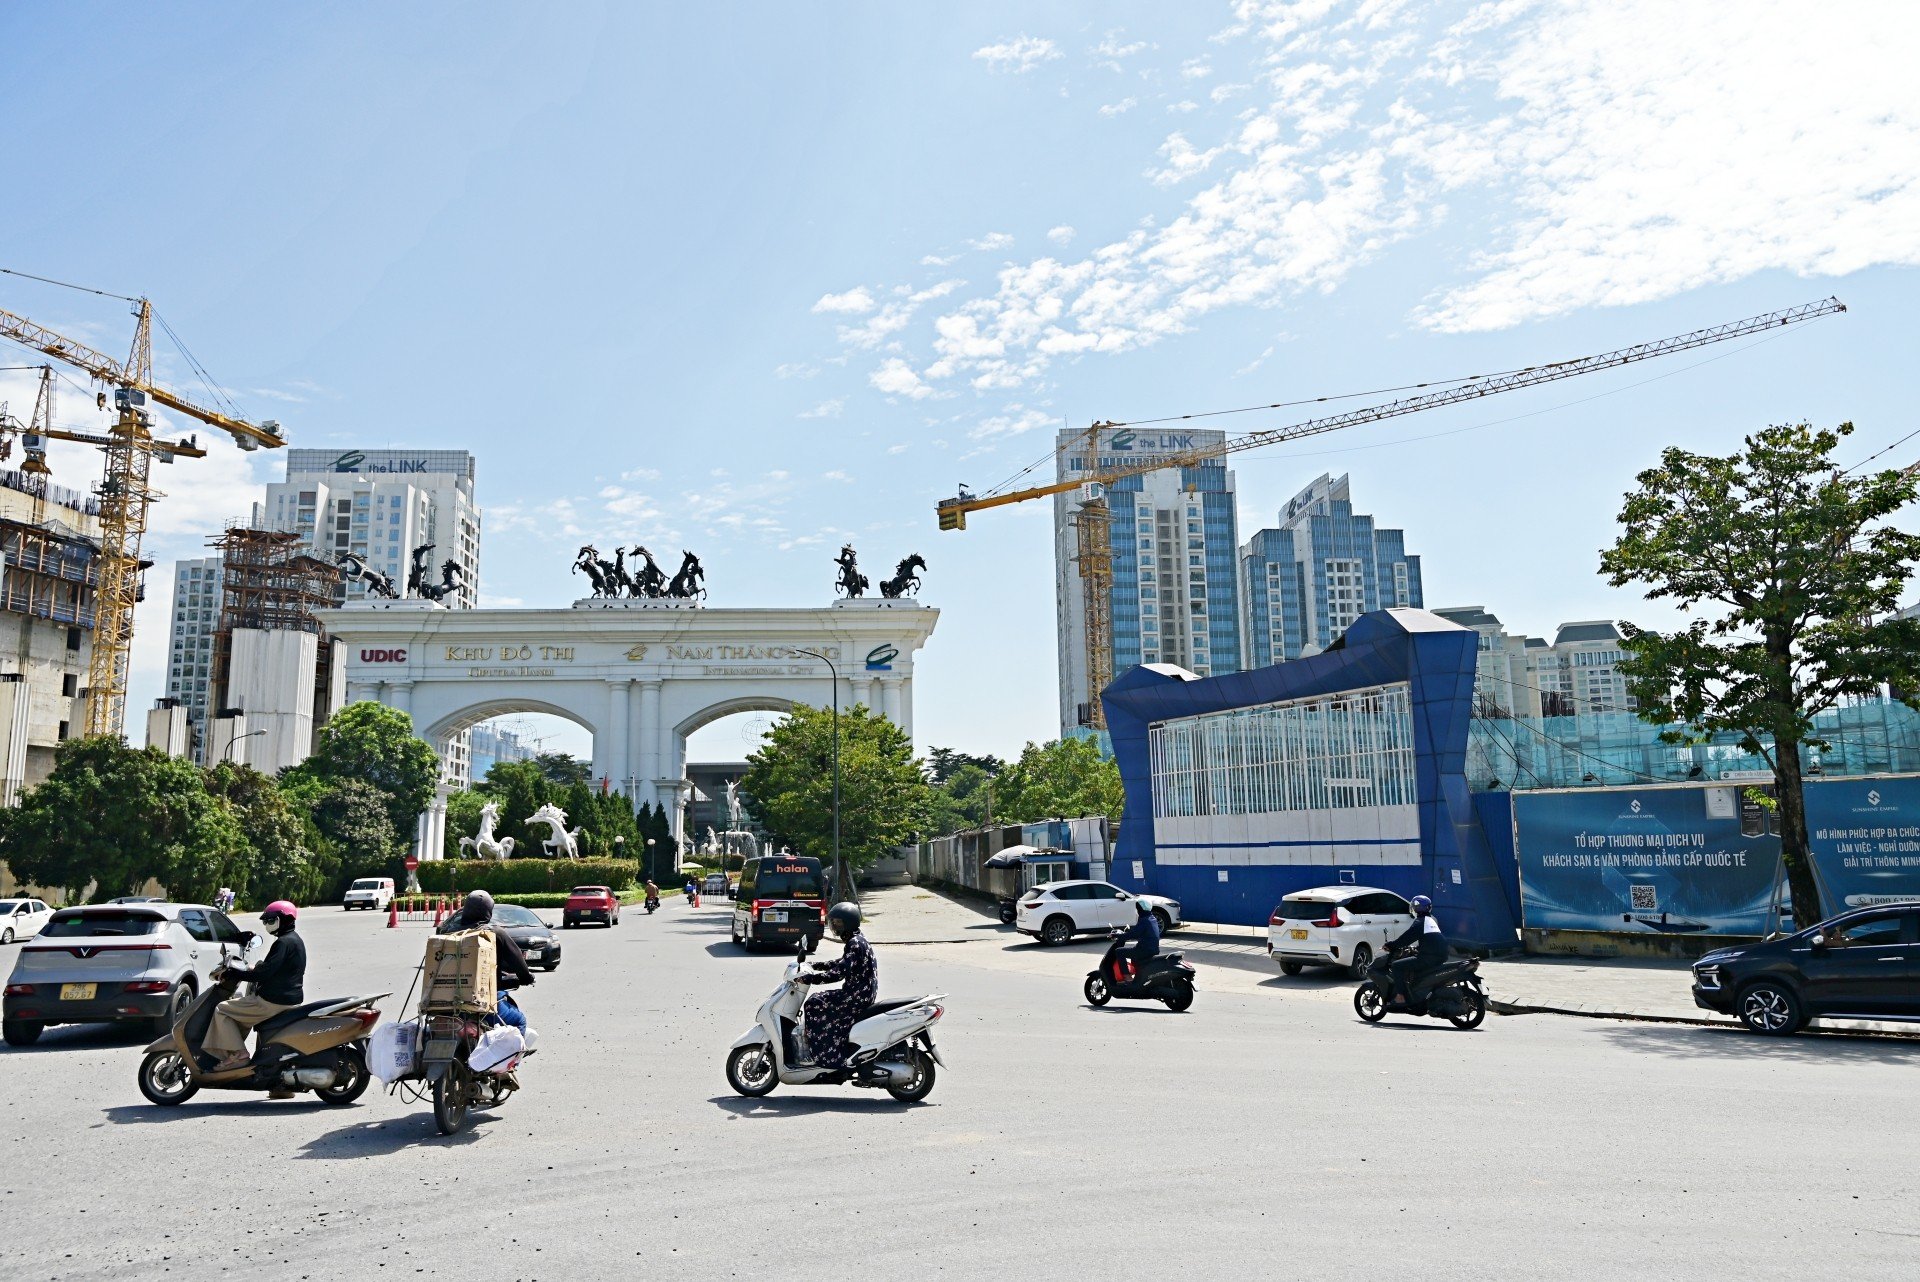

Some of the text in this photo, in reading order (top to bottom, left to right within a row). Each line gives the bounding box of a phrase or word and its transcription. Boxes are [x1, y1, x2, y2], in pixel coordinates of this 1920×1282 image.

[1140, 435, 1193, 448] the LINK
[368, 460, 427, 473] the LINK
[360, 649, 407, 663] UDIC
[445, 643, 575, 663] KHU ĐÔ THỊ
[666, 646, 712, 660] NAM
[1816, 825, 1920, 840] MÔ HÌNH PHỨC HỢP ĐA CHỨC
[1575, 831, 1705, 850] TỔ HỢP THƯƠNG MẠI DỊCH VỤ
[1836, 841, 1853, 853] LÀM
[1854, 841, 1872, 854] VIỆC
[1878, 839, 1897, 852] NGHỈ
[1898, 840, 1920, 852] DƯỠN
[1543, 848, 1747, 869] KHÁCH SẠN & VĂN PHÒNG ĐẲNG CẤP QUỐC TẾ
[1844, 855, 1920, 867] GIẢI TRÍ THÔNG MINH
[776, 864, 809, 873] halan
